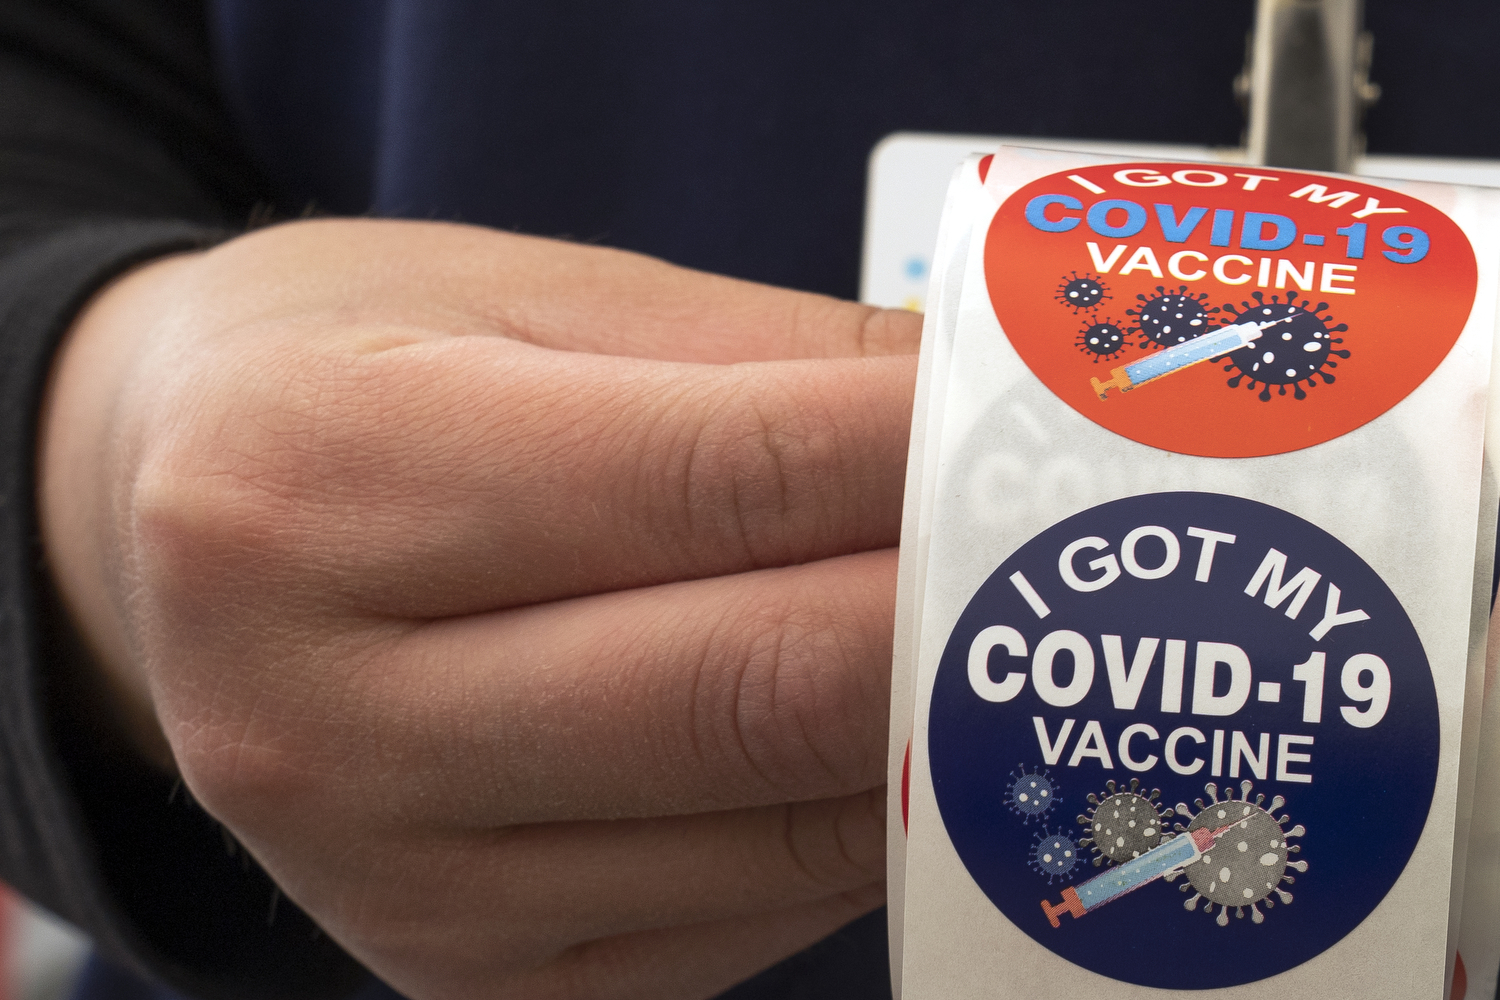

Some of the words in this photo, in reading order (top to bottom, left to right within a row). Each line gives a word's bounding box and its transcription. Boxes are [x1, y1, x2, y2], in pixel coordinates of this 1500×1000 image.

[1025, 193, 1430, 264] COVID-19
[1067, 174, 1106, 194] I
[1113, 170, 1280, 191] GOT
[1290, 183, 1408, 219] MY
[1086, 243, 1358, 295] VACCINE
[1009, 570, 1051, 619] I
[1058, 525, 1236, 592] GOT
[1244, 548, 1371, 641] MY
[967, 625, 1391, 728] COVID-19
[1033, 717, 1314, 783] VACCINE
